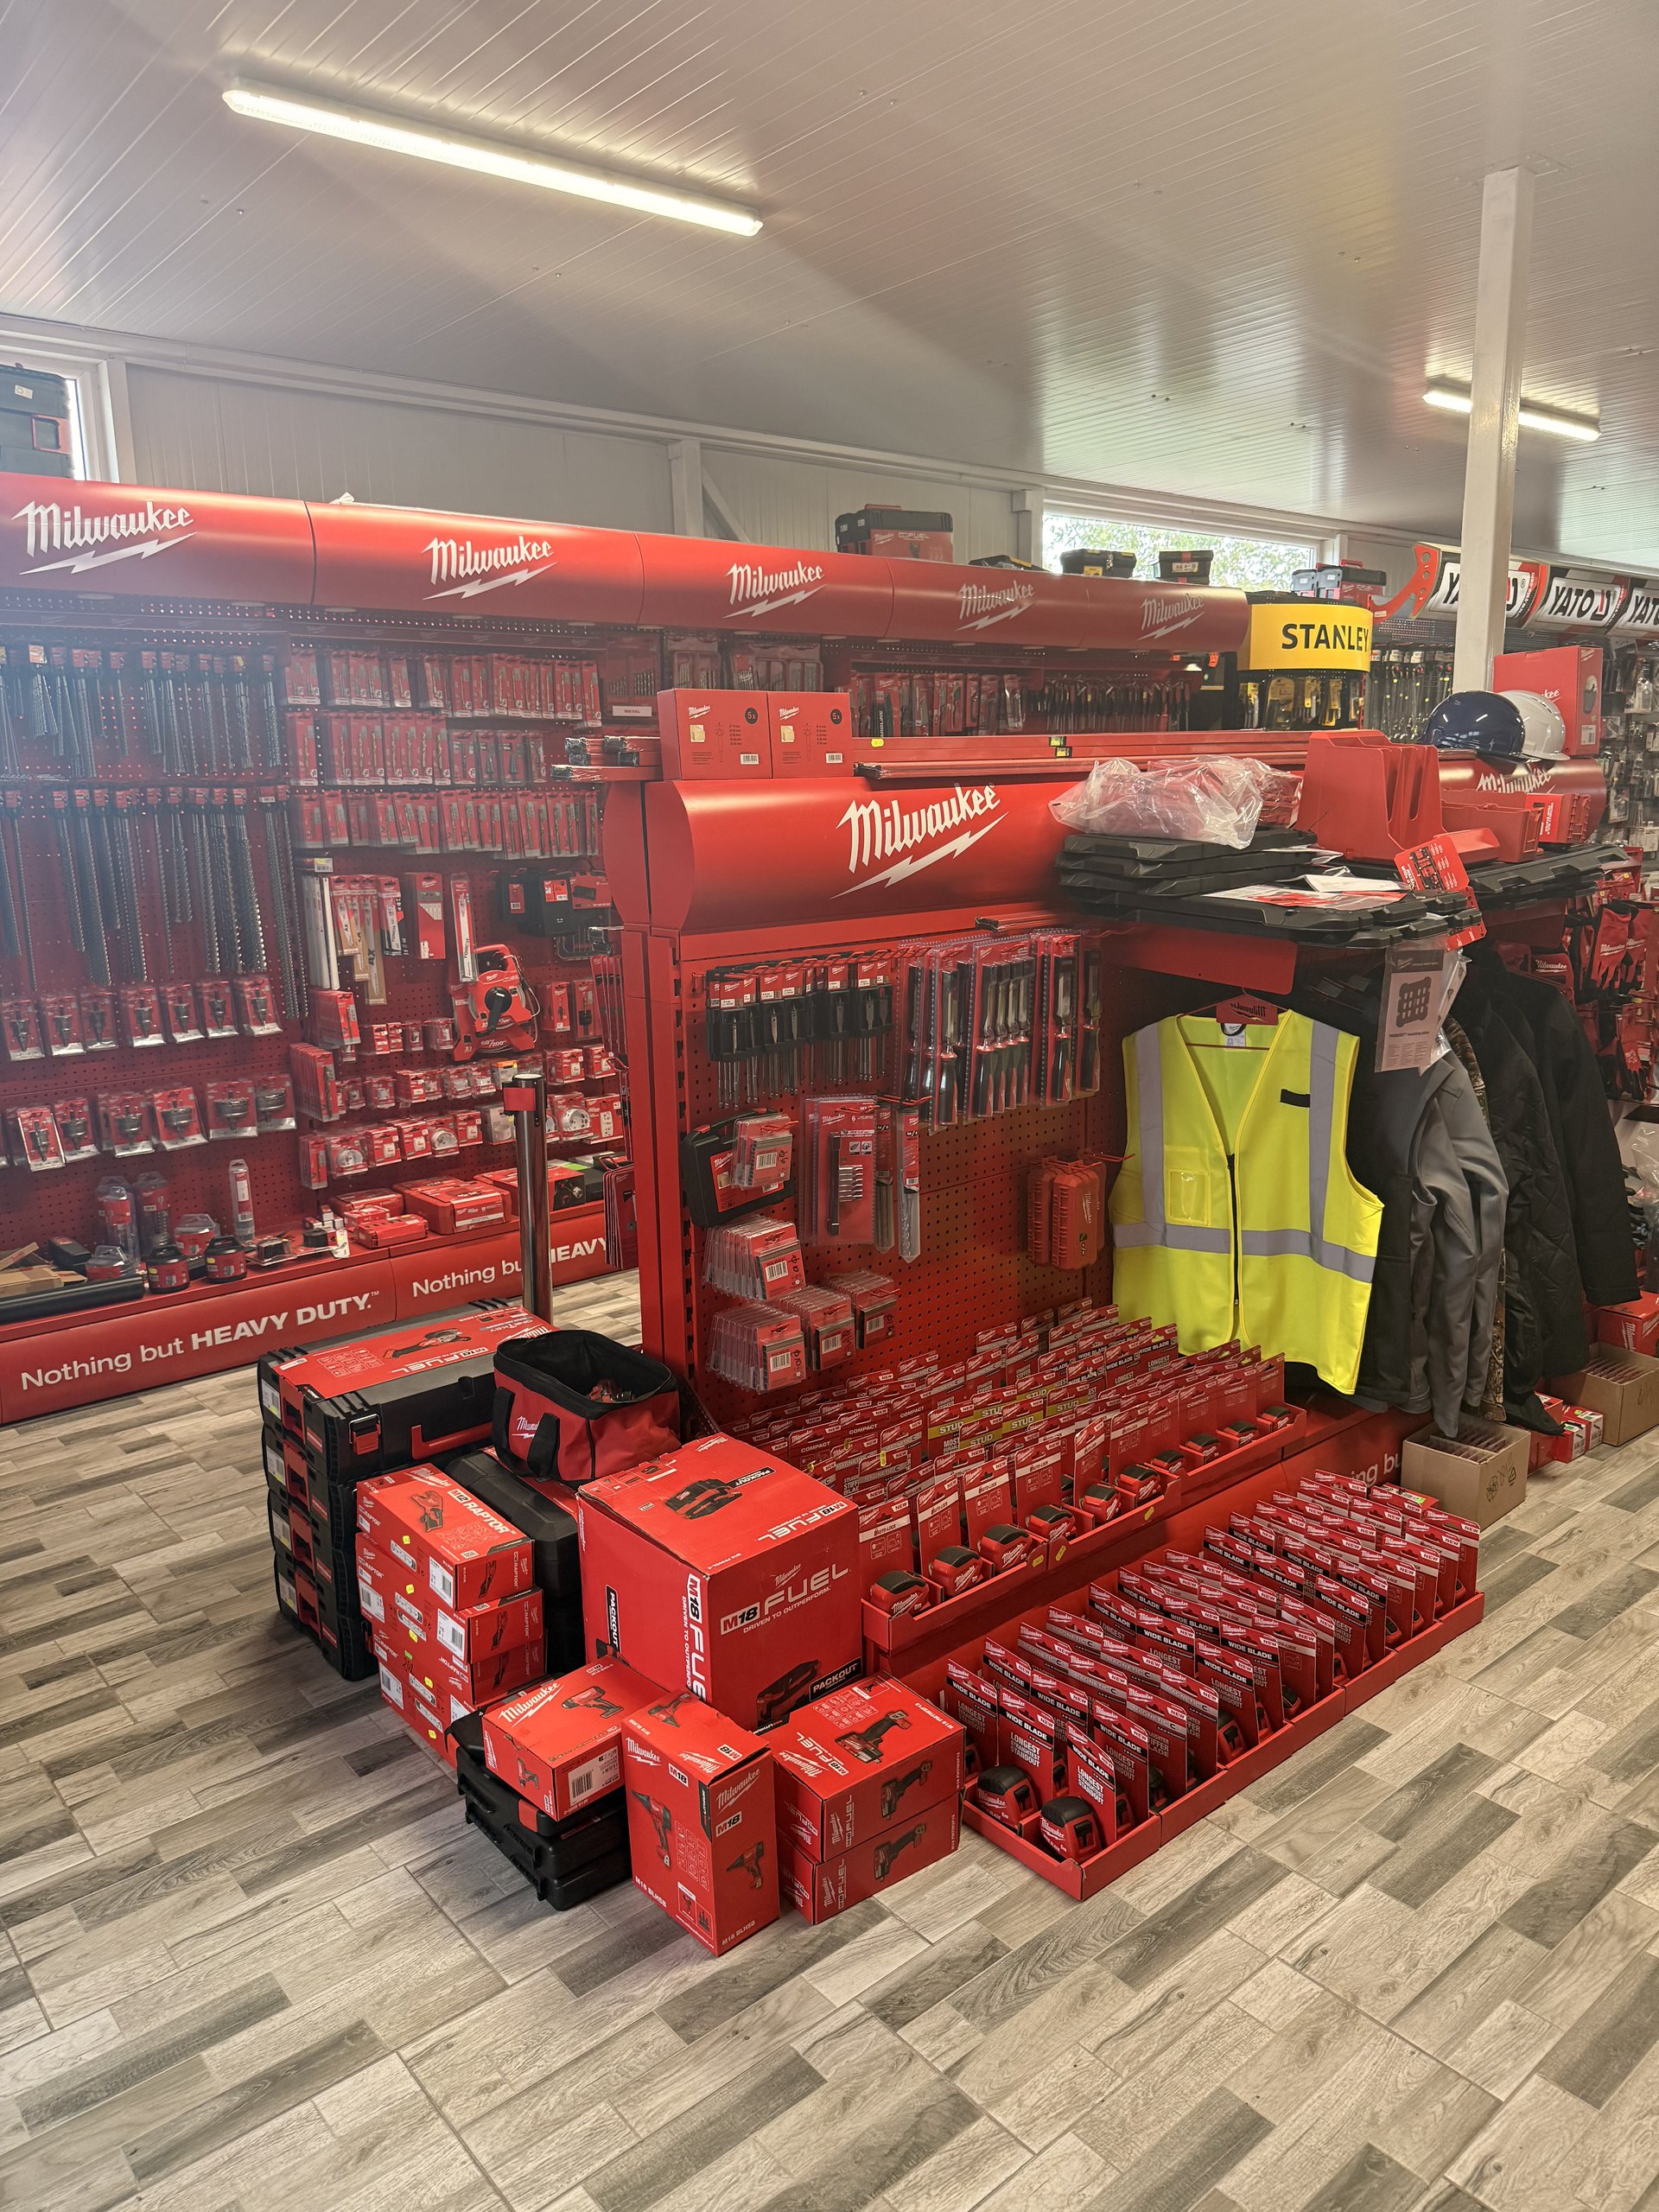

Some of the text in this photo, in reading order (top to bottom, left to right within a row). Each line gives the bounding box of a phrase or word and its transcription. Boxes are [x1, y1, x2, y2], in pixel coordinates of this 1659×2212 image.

[11, 500, 194, 556] Milwaukee
[422, 534, 555, 585] Milwaukee
[725, 561, 825, 605] Milwaukee
[956, 580, 1036, 620] Milwaukee
[1141, 593, 1205, 631] Milwaukee
[1548, 585, 1595, 617] YATO
[1281, 623, 1370, 653] STANLEY
[835, 782, 1001, 874] Milwaukee
[501, 1260, 523, 1275] bu
[411, 1266, 496, 1298] Nothing
[21, 1351, 132, 1390] Nothing
[140, 1338, 184, 1363] but
[191, 1312, 289, 1351] HEAVY
[391, 1351, 463, 1374] FUEL
[1224, 1384, 1249, 1395] COMPACT
[899, 1406, 925, 1418] COMPACT
[1057, 1400, 1079, 1412] STUD
[849, 1423, 878, 1434] COMPACT
[939, 1421, 964, 1434] STUD
[1011, 1415, 1034, 1429] STUD
[801, 1441, 831, 1452] COMPACT
[969, 1434, 993, 1446] STUD
[734, 1469, 772, 1487] PACKOUT
[449, 1488, 470, 1503] M12
[757, 1501, 846, 1542] M18 FUEL
[1234, 1530, 1268, 1550] WIDE BLADE
[1208, 1543, 1244, 1565] WIDE BLADE
[1287, 1552, 1324, 1574] WIDE BLADE
[775, 1563, 802, 1586] Milwaukee
[1259, 1567, 1297, 1589] WIDE BLADE
[721, 1563, 849, 1633] M18 FUEL
[1123, 1586, 1160, 1610] WIDE BLADE
[1342, 1576, 1380, 1600] WIDE BLADE
[1094, 1602, 1132, 1628] WIDE BLADE
[1320, 1592, 1360, 1619] WIDE BLADE
[610, 1592, 619, 1649] PACKOUT
[743, 1616, 772, 1634] DRIVEN
[772, 1611, 783, 1620] TO
[1170, 1613, 1214, 1633] WIDE BLADE
[683, 1630, 690, 1641] TO
[688, 1577, 706, 1702] M18 FUE
[1143, 1630, 1188, 1651] WIDE BLADE
[1228, 1641, 1273, 1660] WIDE BLADE
[813, 1662, 858, 1694] PACKOUT
[988, 1659, 1025, 1687] WIDE BLADE
[1204, 1659, 1247, 1684] WIDE BLADE
[498, 1682, 561, 1723] Milwaukee
[952, 1681, 991, 1709] WIDE BLADE
[1002, 1693, 1026, 1708] Milwaukee
[1037, 1692, 1080, 1718] WIDE BLADE
[1006, 1711, 1047, 1741] WIDE BLADE
[1069, 1725, 1089, 1743] Milwaukee
[1100, 1724, 1141, 1753] WIDE BLADE
[626, 1737, 660, 1763] Milwaukee
[719, 1745, 741, 1760] M18
[796, 1732, 849, 1776] M18 FUEL
[1011, 1732, 1040, 1755] LONGEST
[678, 1751, 720, 1774] Milwaukee
[779, 1751, 823, 1778] Milwaukee
[1011, 1745, 1040, 1768] STANDOUT
[1072, 1745, 1109, 1780] WIDE BLADE
[669, 1764, 689, 1786] M18
[1077, 1764, 1104, 1793] LONGEST
[715, 1768, 760, 1810] Milwaukee
[1077, 1780, 1104, 1805] STANDOUT
[716, 1814, 741, 1836] M18
[635, 1876, 666, 1908] M18 BLHSB
[721, 1920, 755, 1946] M18 BLHSB
